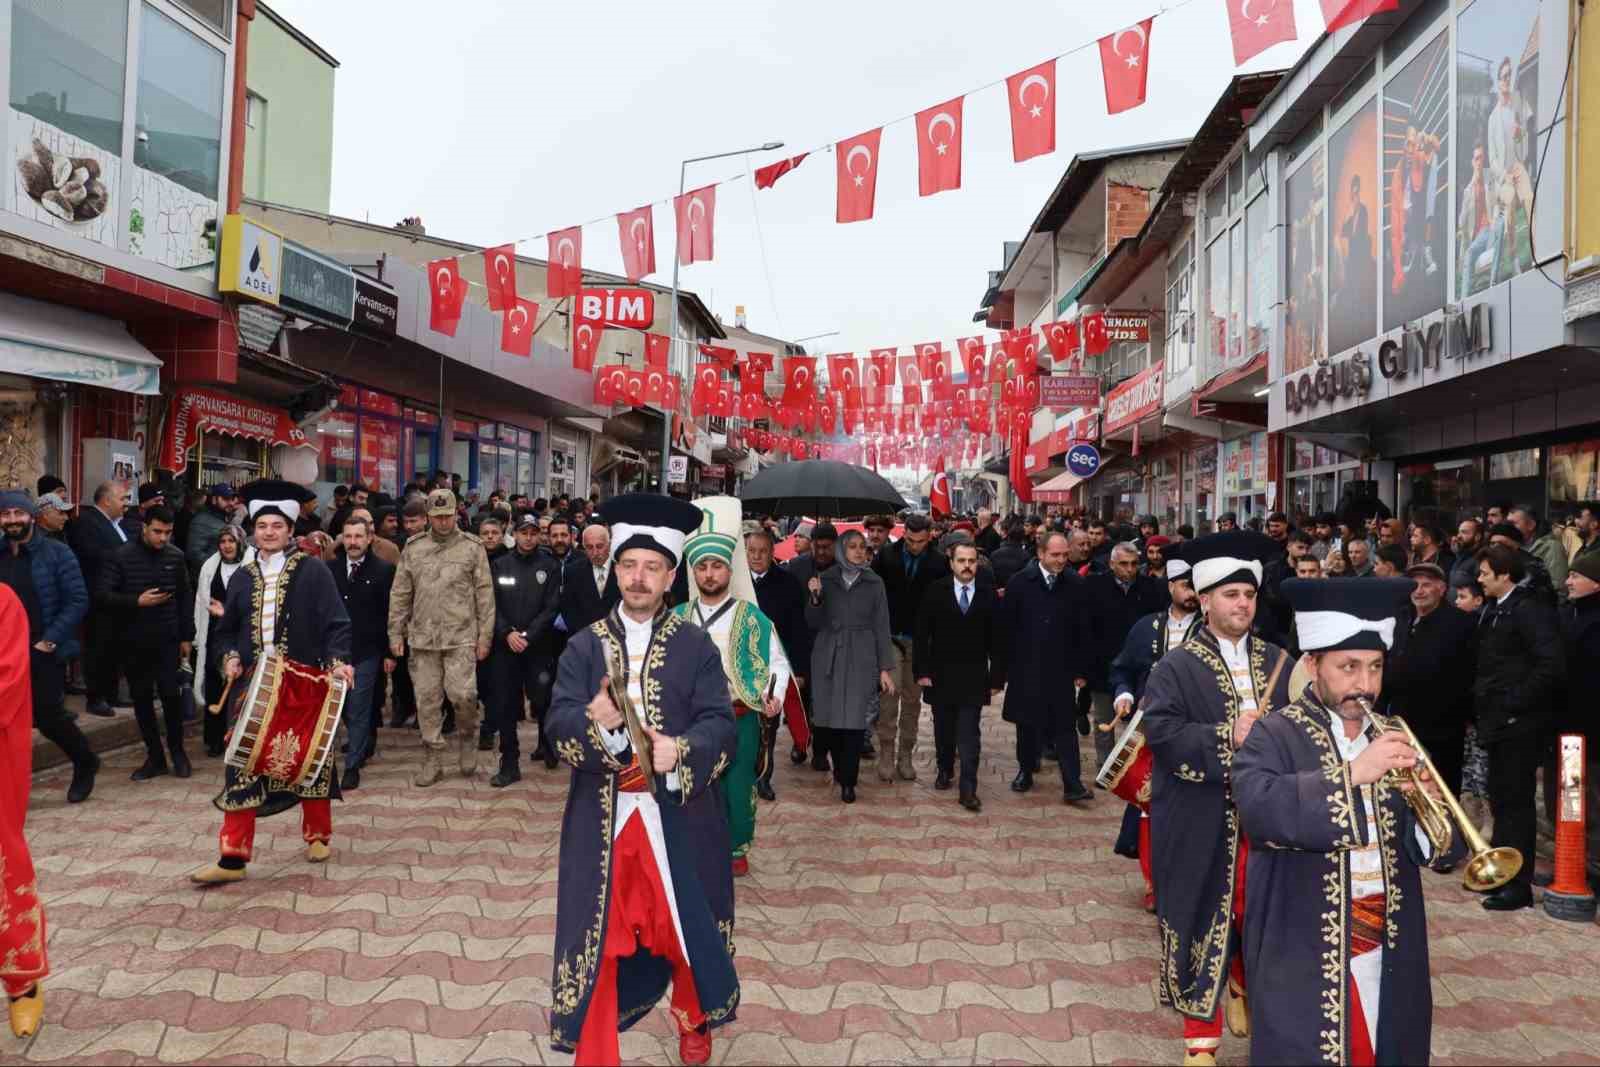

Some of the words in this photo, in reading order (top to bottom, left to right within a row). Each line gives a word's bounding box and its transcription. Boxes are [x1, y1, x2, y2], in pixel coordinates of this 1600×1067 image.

[244, 276, 273, 295] ADEL
[582, 289, 644, 320] BİM
[1285, 352, 1370, 413] DOĞUŞ
[1378, 303, 1490, 379] GİYİM
[1071, 452, 1097, 467] sec
